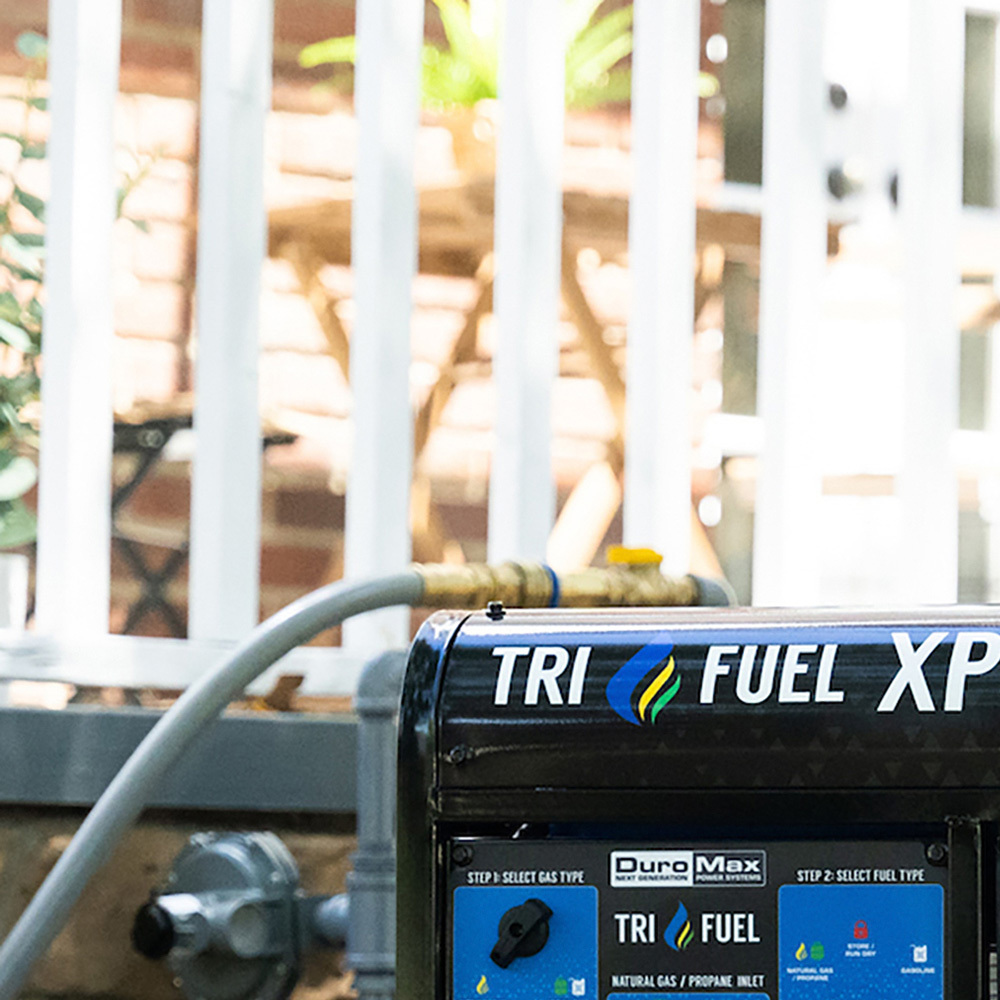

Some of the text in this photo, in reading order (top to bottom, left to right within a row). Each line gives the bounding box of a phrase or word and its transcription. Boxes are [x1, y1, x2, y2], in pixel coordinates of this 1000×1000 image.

[492, 646, 592, 705] TRI
[699, 644, 845, 704] FUEL
[615, 855, 761, 873] Duro Max
[467, 871, 492, 884] STEP
[502, 871, 536, 884] SELECT
[538, 871, 558, 884] GAS
[560, 871, 585, 884] TYPE
[797, 869, 925, 882] STEP 2: SELECT FUEL TYPE
[614, 913, 760, 943] TRI FUEL
[612, 975, 655, 988] NATURAL
[657, 975, 677, 988] GAS
[688, 975, 733, 988] PROPANE
[737, 975, 765, 988] INLET
